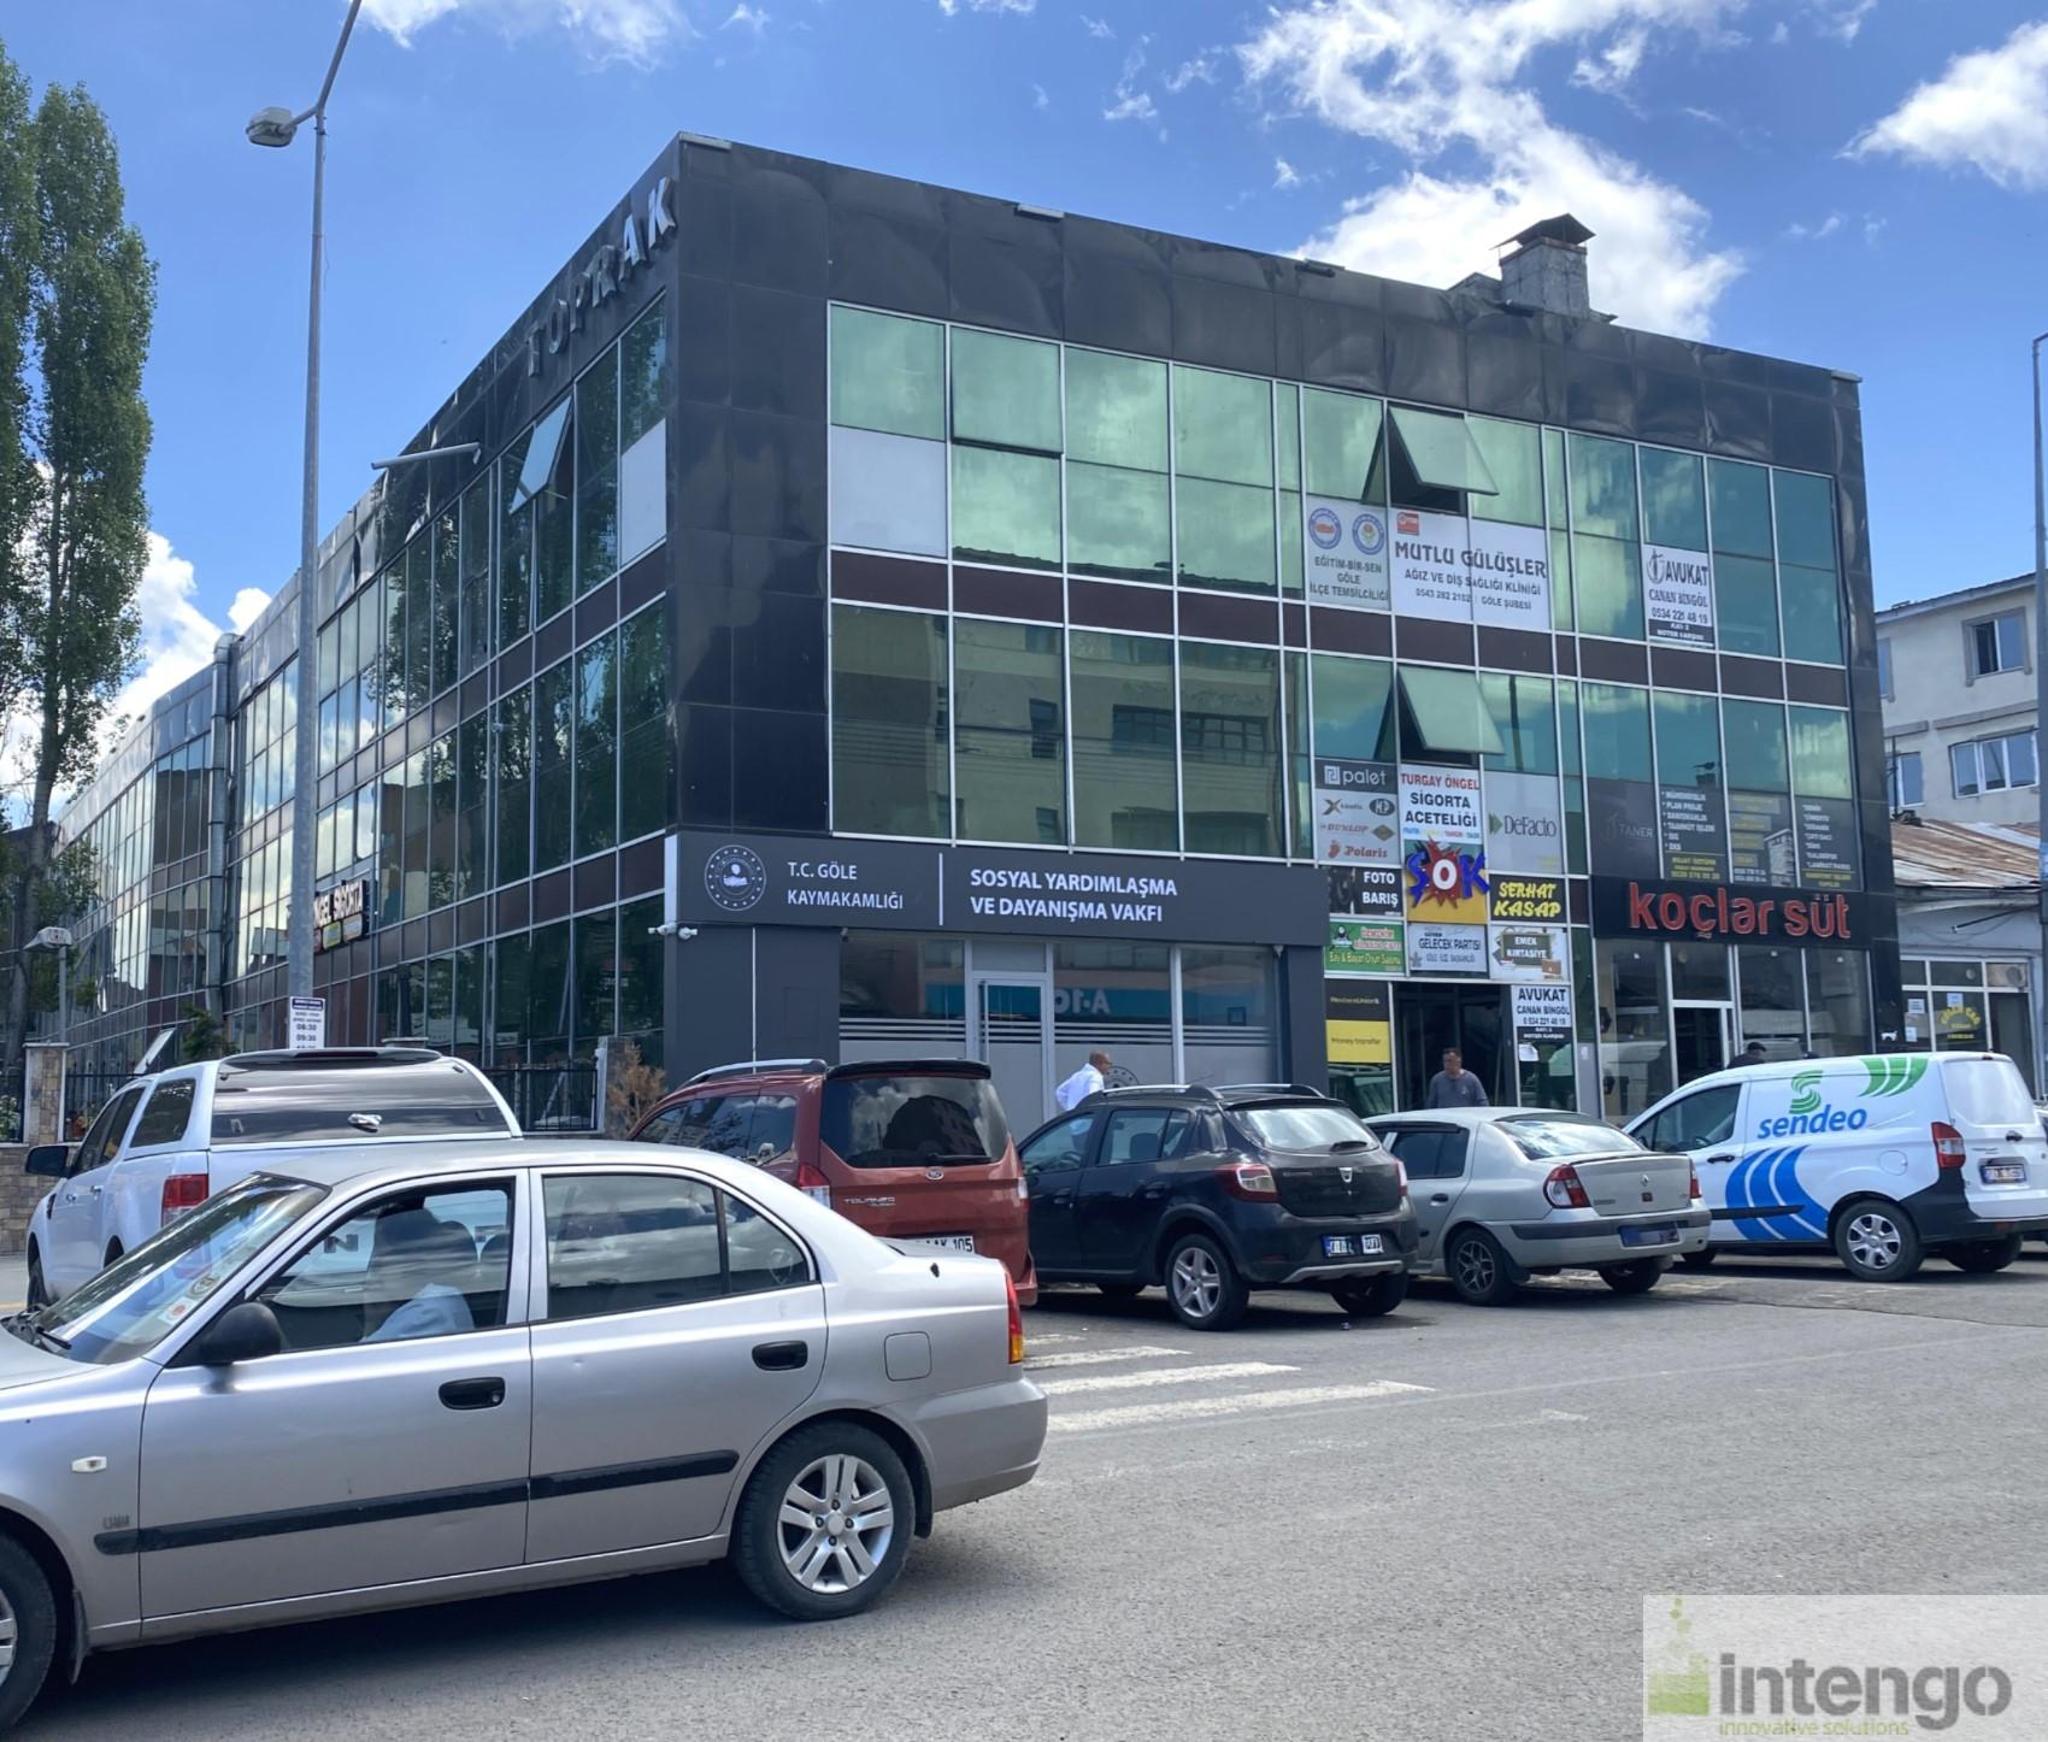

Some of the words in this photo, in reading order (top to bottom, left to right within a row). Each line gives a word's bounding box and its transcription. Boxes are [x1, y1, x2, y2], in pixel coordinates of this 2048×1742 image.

[524, 175, 677, 377] TOPRAK
[1395, 541, 1455, 565] MUTLU
[1460, 548, 1547, 579] GÜLÜŞLER
[1337, 571, 1361, 585] GÖLE
[1405, 567, 1428, 581] AĞIZ
[1431, 573, 1447, 584] VE
[1447, 572, 1463, 588] DİŞ
[1666, 560, 1708, 587] AVUKAT
[1649, 588, 1676, 603] CANAN
[1342, 768, 1387, 786] palet
[1401, 773, 1441, 787] TURGAY
[1445, 773, 1480, 790] ÖNGEL
[1410, 789, 1471, 808] SİGORTA
[1404, 810, 1477, 828] ACETELİĞİ
[1504, 815, 1557, 838] DeFacto
[1344, 845, 1388, 858] Polaris
[787, 862, 814, 878] T.C.
[818, 860, 857, 880] GÖLE
[1363, 871, 1395, 884] FOTO
[970, 869, 1042, 889] SOSYAL
[1045, 872, 1178, 898] YARDIMLAŞMA
[1499, 882, 1557, 898] SERHAT
[787, 889, 903, 909] KAYMAKAMLIĞI
[1362, 891, 1398, 907] BARIŞ
[970, 896, 995, 914] VE
[999, 897, 1107, 922] DAYANIŞMA
[1111, 903, 1162, 922] VAKFI
[1494, 900, 1562, 918] KASAP
[1629, 881, 1774, 940] koçlar
[1783, 893, 1851, 940] süt
[1519, 987, 1566, 1001] AVUKAT
[1517, 1005, 1541, 1014] CANAN
[1757, 1104, 1867, 1139] sendeo
